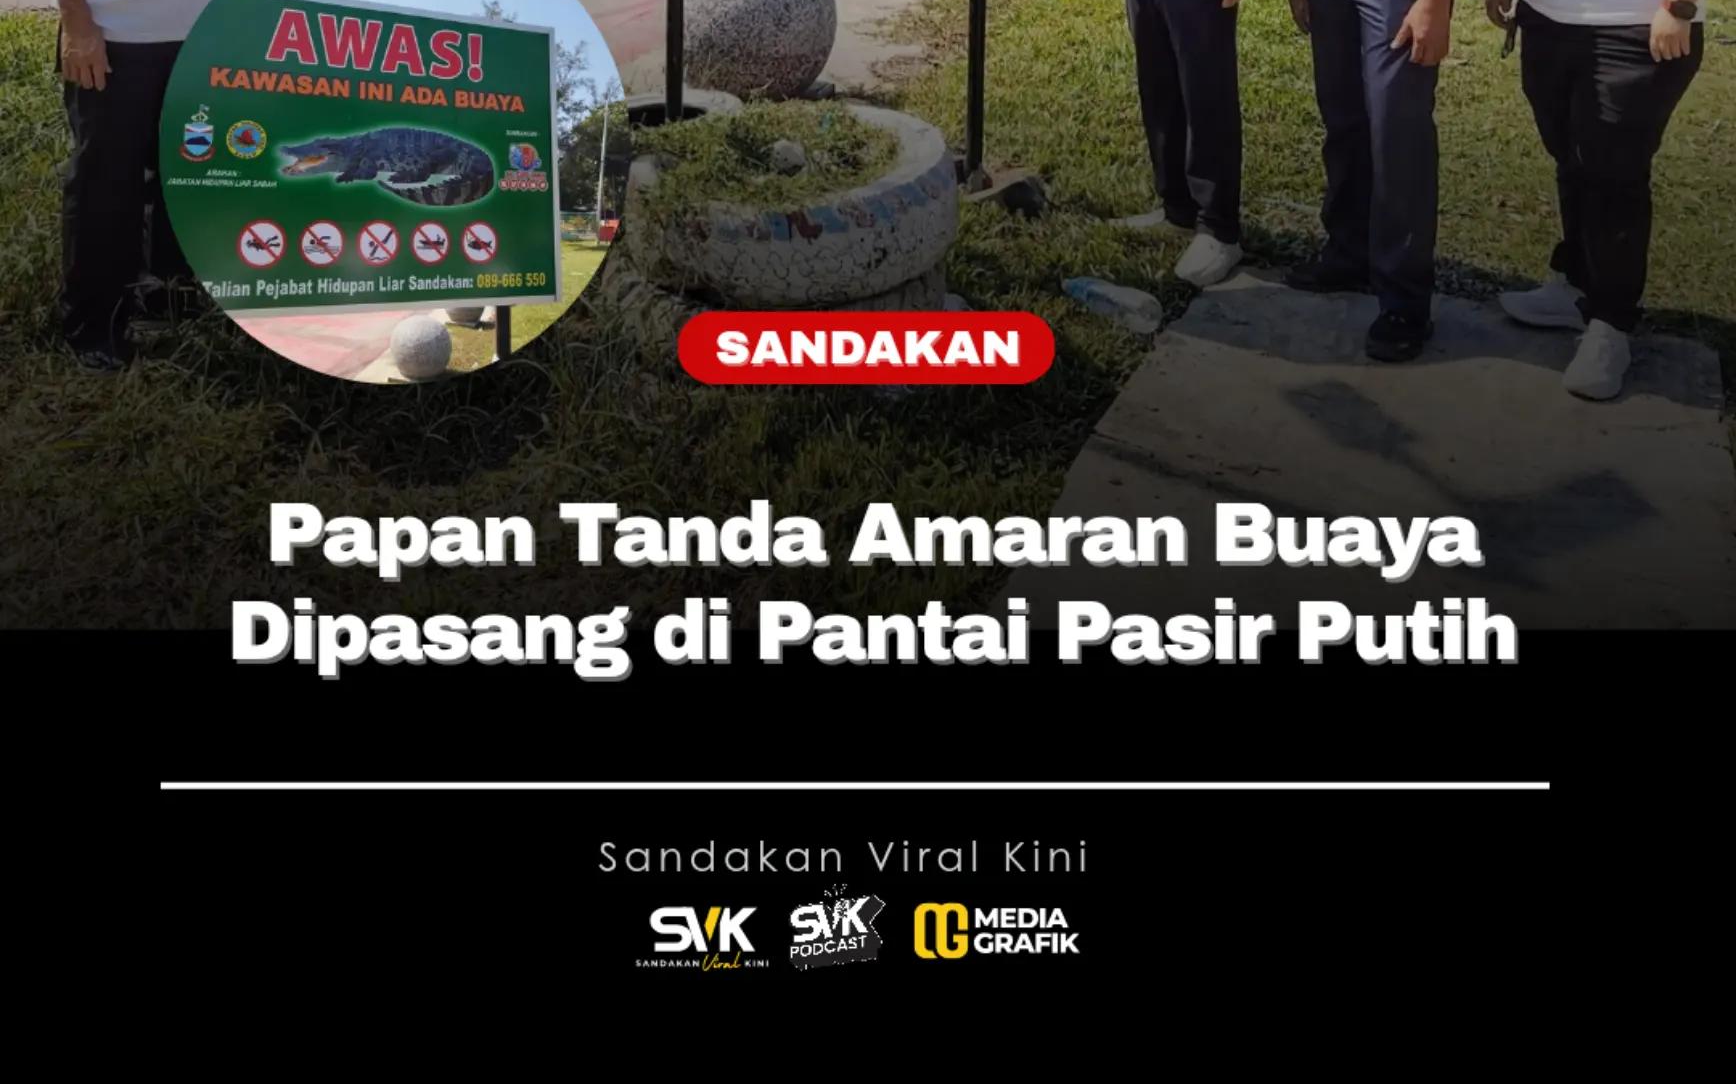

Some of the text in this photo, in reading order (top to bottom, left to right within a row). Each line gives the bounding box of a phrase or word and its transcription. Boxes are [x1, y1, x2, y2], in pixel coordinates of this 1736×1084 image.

[265, 8, 484, 83] AWAS!
[210, 67, 525, 113] KAWASAN INI ADA BUAYA
[256, 278, 312, 300] Pejabat
[317, 276, 375, 296] Hidupan
[379, 276, 406, 292] Liar
[408, 274, 474, 291] Sandakan:
[476, 273, 523, 288] 089-666
[525, 272, 546, 287] 550
